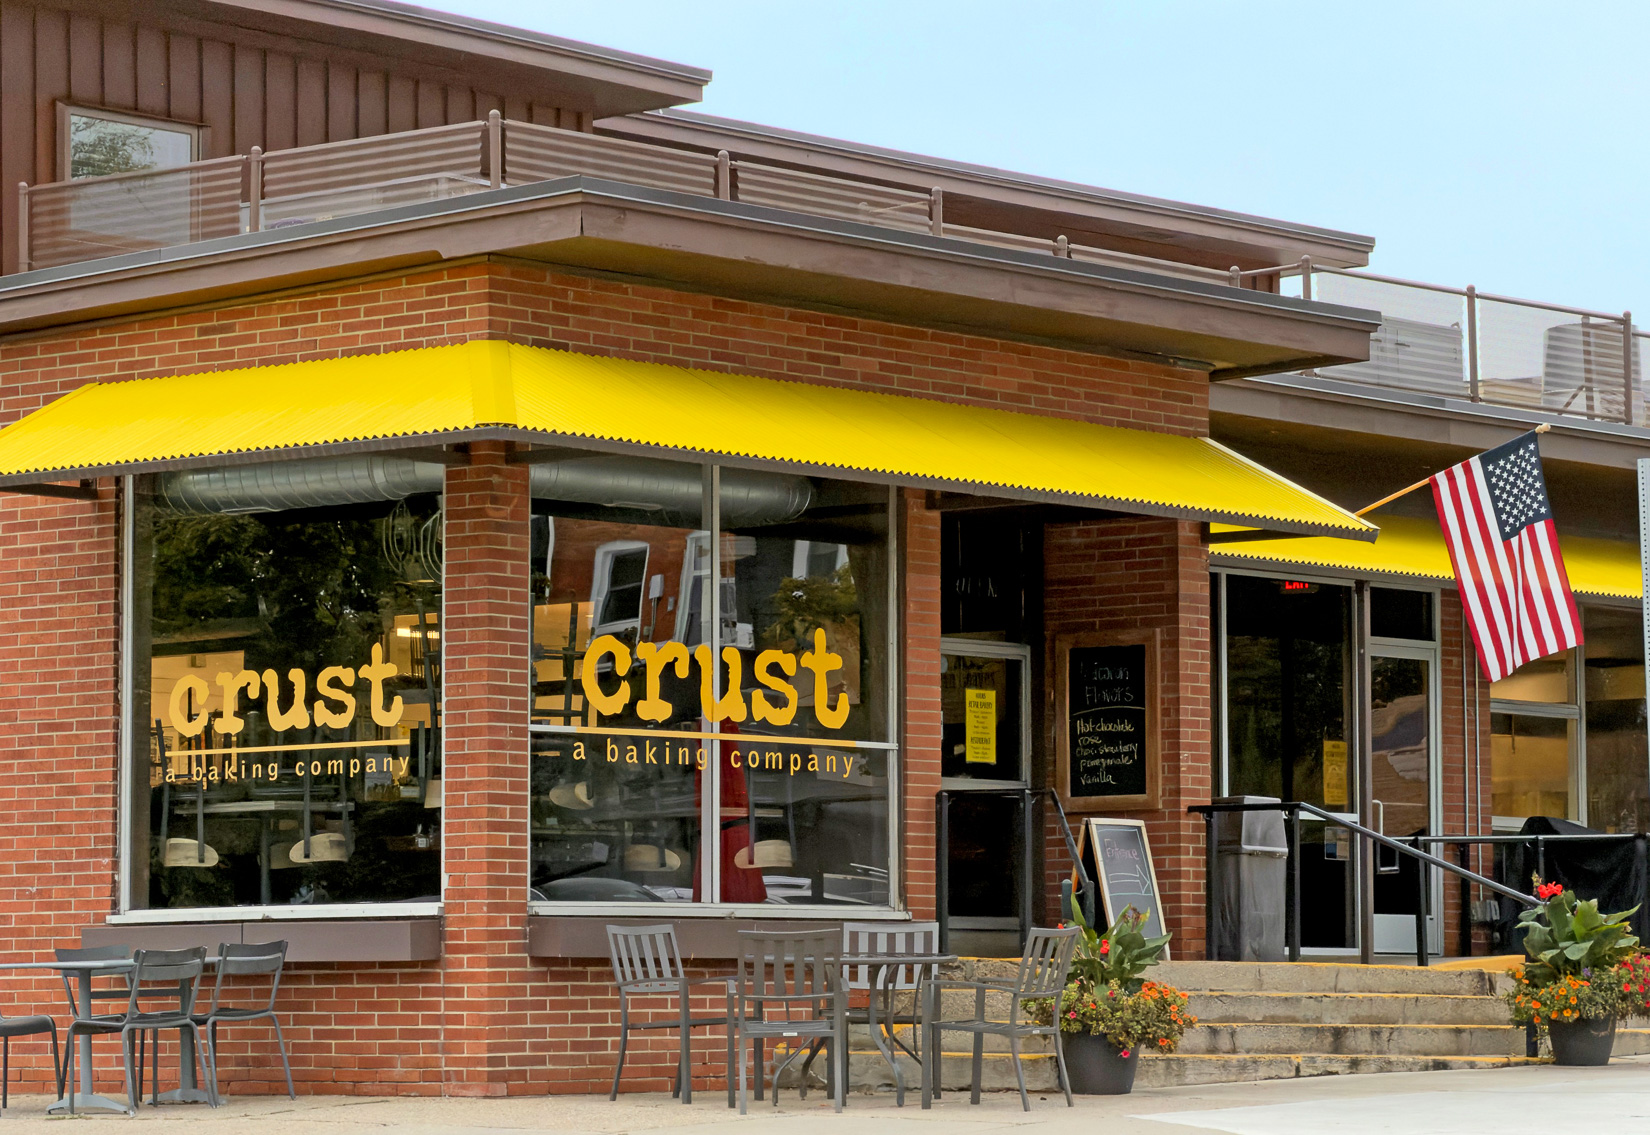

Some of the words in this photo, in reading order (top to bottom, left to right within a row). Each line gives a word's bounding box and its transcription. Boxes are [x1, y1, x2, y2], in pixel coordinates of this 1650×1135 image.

[169, 642, 404, 738] crust
[581, 627, 850, 729] crust
[165, 768, 176, 782] a
[193, 760, 279, 781] baking
[295, 756, 410, 778] company
[572, 741, 586, 760] a
[606, 737, 708, 770] baking
[730, 749, 854, 778] company
[1080, 769, 1118, 786] vanilla
